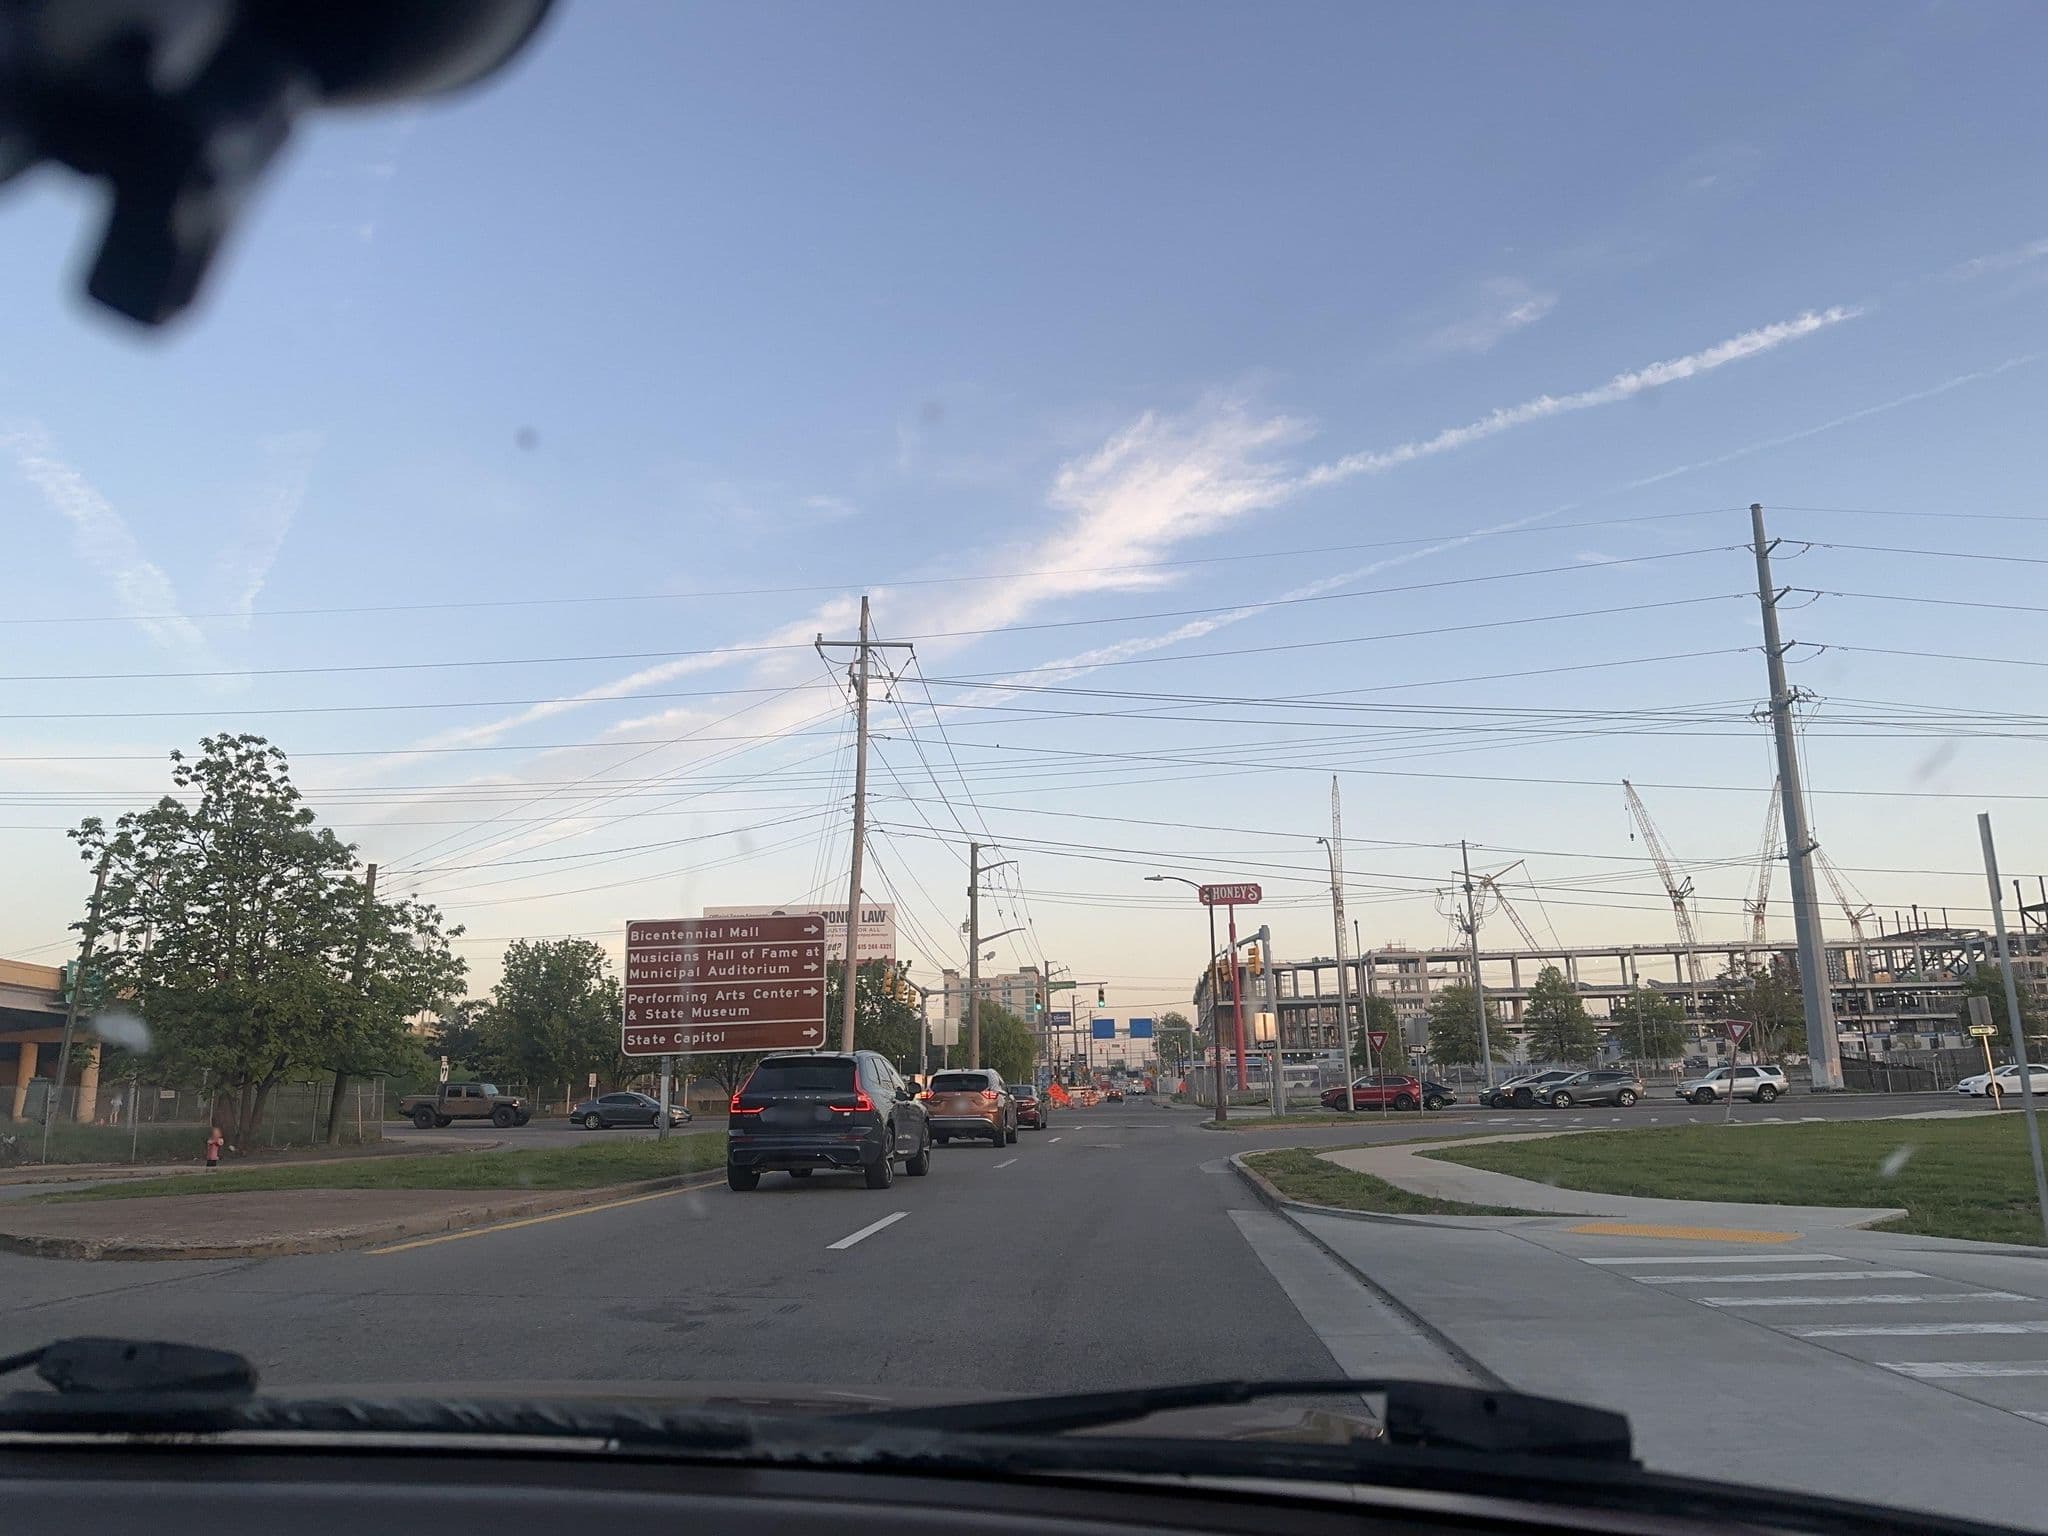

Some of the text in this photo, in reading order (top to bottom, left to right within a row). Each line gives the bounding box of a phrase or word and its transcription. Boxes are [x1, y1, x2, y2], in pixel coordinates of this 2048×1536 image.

[861, 910, 886, 923] LAW
[630, 926, 759, 941] Bicentennial Mall
[630, 946, 820, 963] Musicians Hall of Fame at
[629, 963, 790, 979] Municipal Auditorium
[628, 987, 800, 1004] Performing Arts Center
[627, 1007, 750, 1020] & State Museum
[627, 1031, 725, 1046] State Capitol
